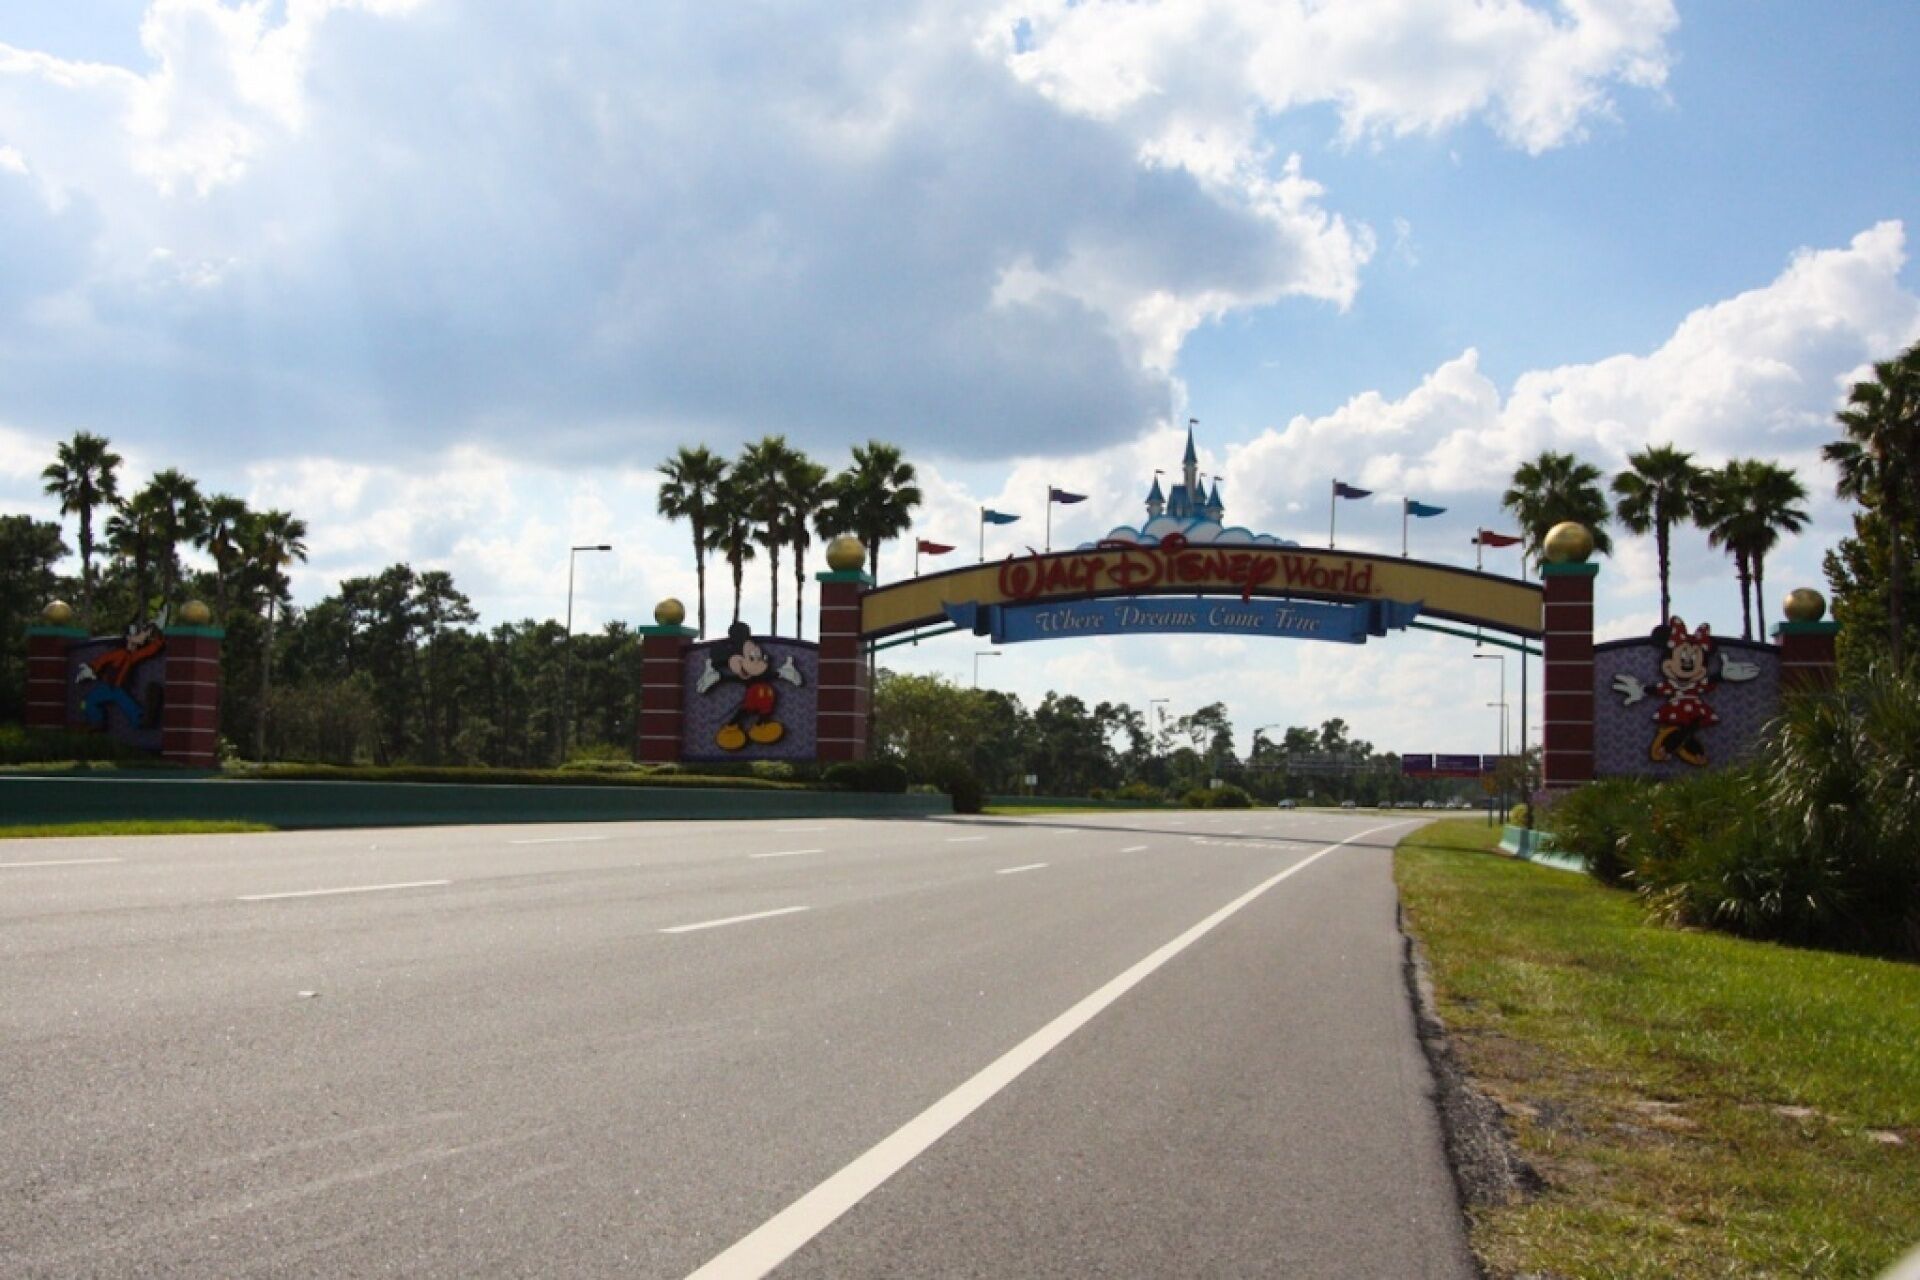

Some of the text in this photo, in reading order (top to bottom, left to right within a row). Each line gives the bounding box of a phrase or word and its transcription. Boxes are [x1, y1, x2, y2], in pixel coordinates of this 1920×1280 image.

[1282, 556, 1373, 594] World
[1036, 605, 1321, 632] Where Dreams Come True
